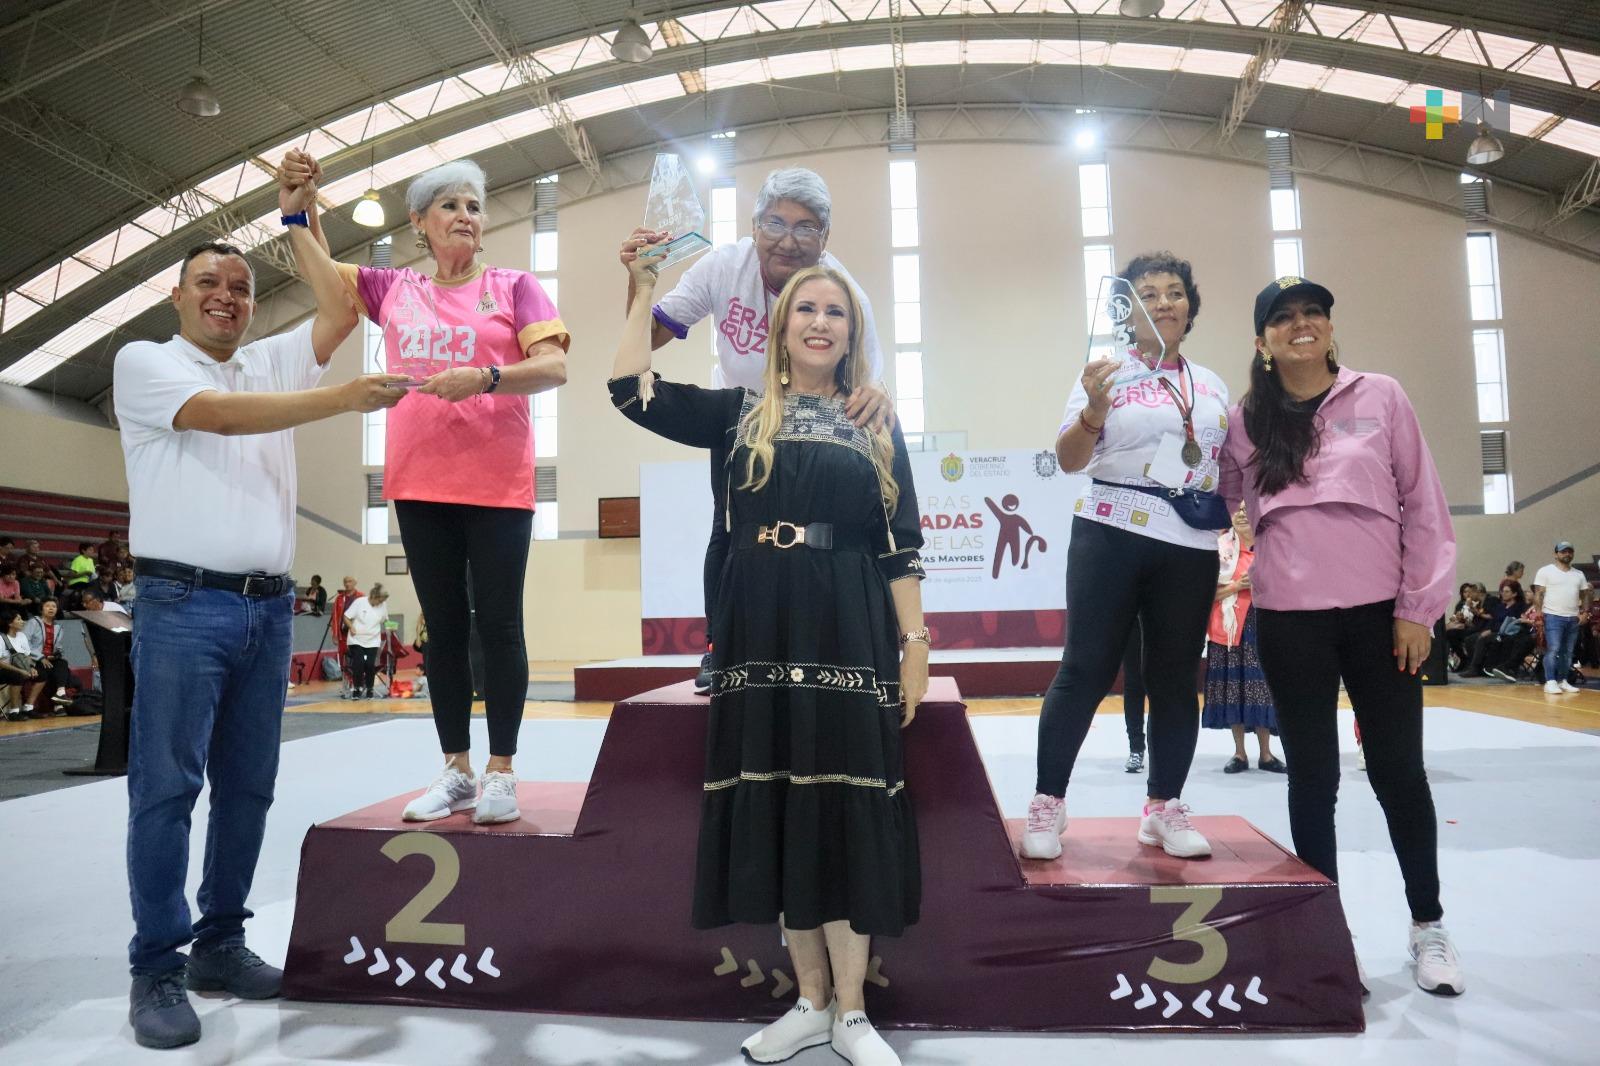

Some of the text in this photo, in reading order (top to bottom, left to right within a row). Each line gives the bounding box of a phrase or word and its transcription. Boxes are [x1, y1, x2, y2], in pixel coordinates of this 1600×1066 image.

[969, 456, 1007, 464] VERACRUZ
[969, 463, 1005, 471] GOBIERNO
[969, 469, 1011, 478] DEL ESTADO
[950, 535, 985, 550] LAS
[379, 831, 466, 946] 2
[1146, 886, 1228, 985] 3
